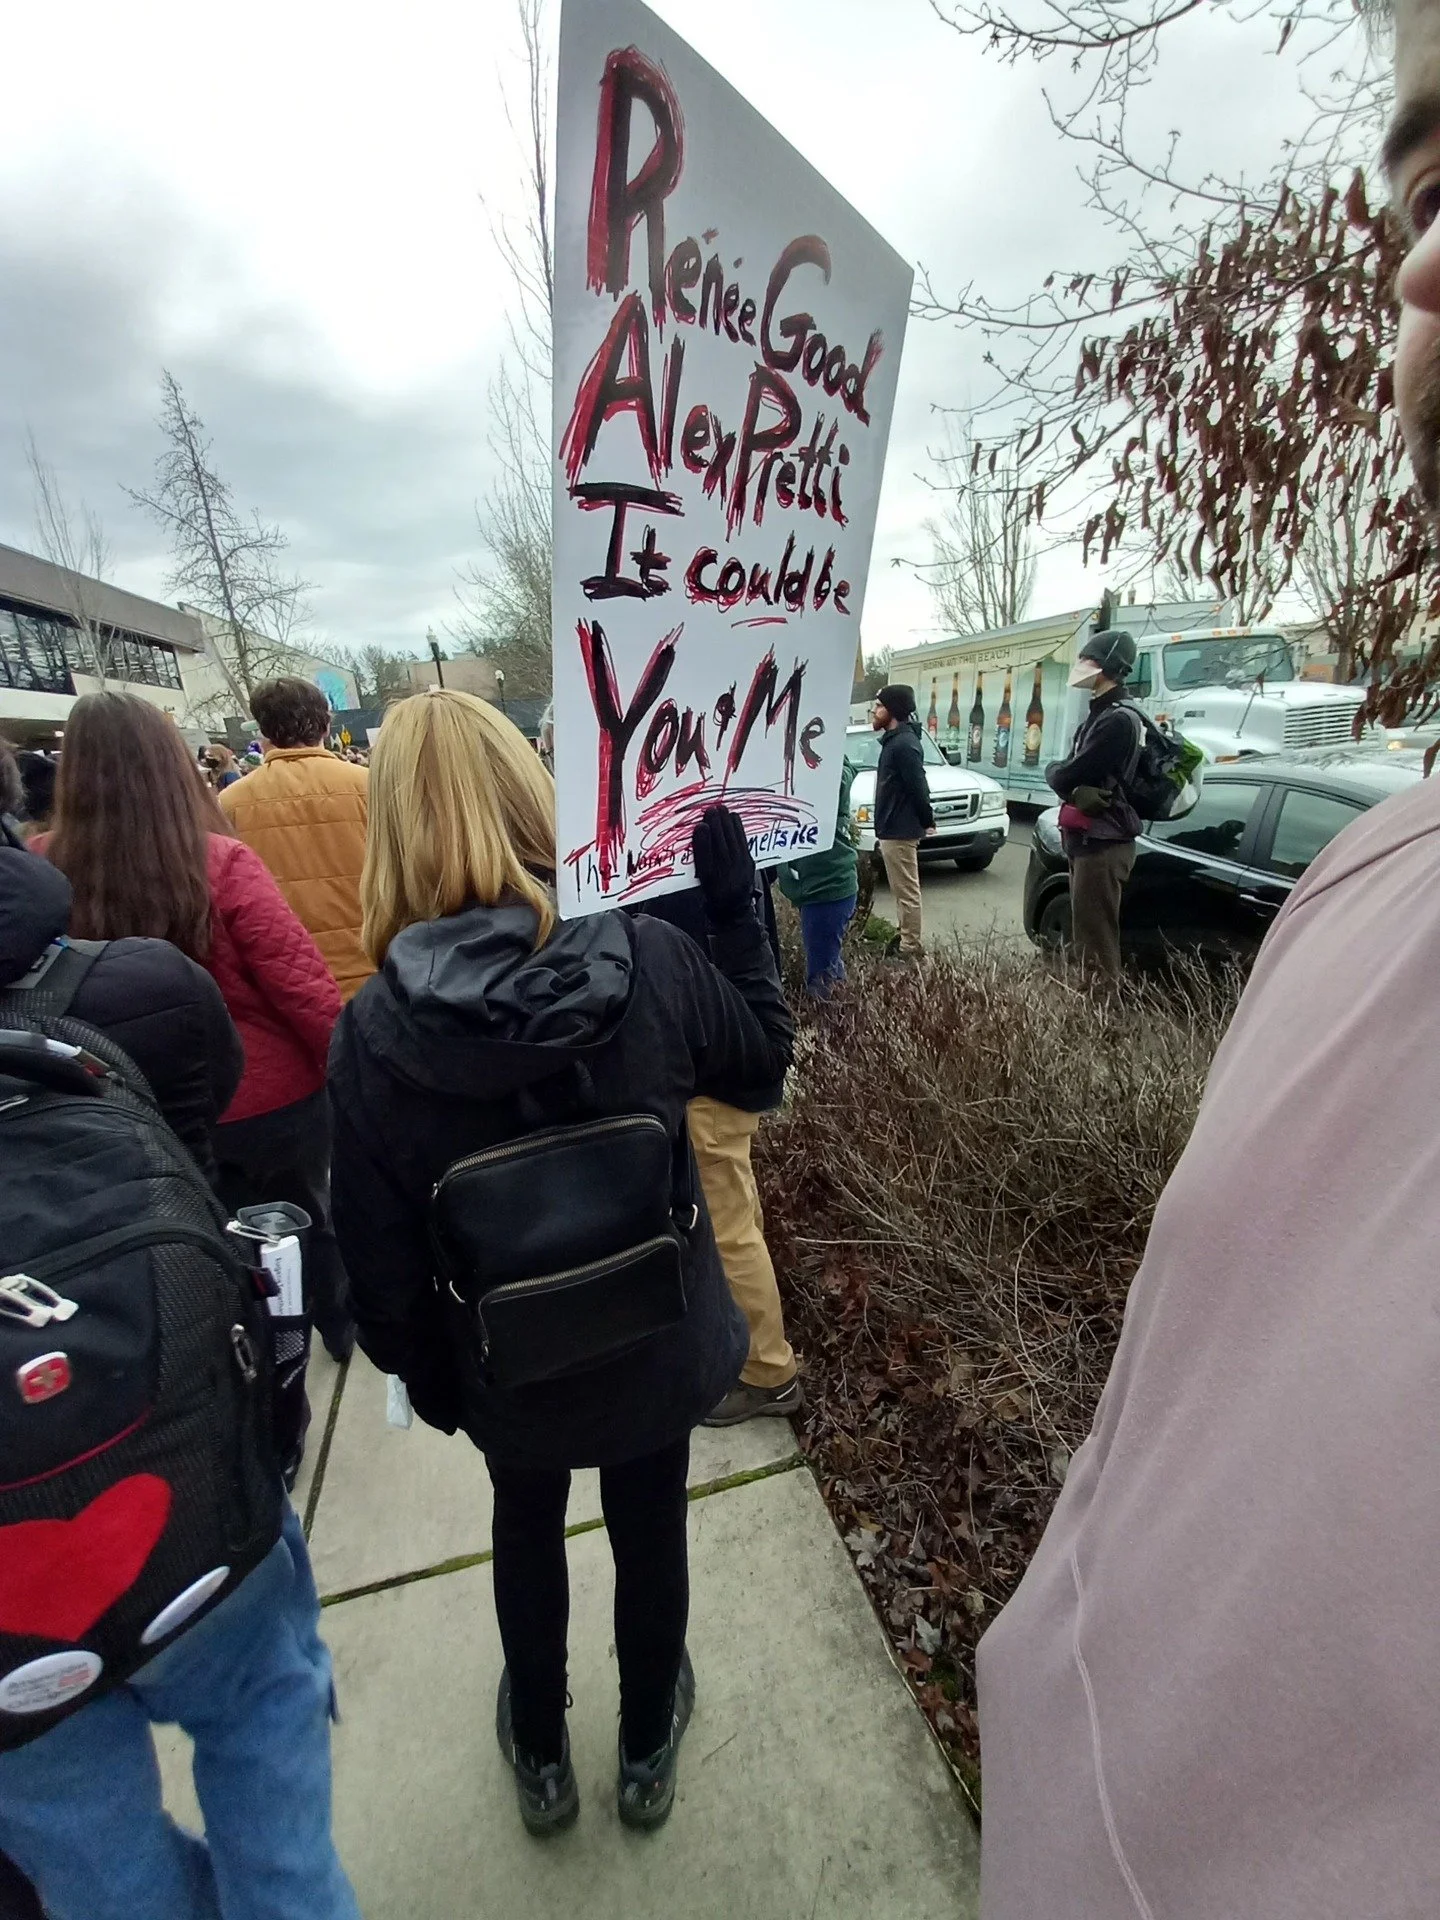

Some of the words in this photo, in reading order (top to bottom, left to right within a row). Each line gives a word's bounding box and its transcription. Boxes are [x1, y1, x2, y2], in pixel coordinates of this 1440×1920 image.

[760, 234, 885, 428] Good
[558, 289, 736, 510] Alex
[726, 361, 850, 543] Pretti
[567, 481, 685, 602] It
[684, 530, 813, 618] could
[812, 543, 852, 615] be
[977, 648, 1011, 663] BEACH
[575, 617, 711, 880] You
[724, 643, 826, 797] Me
[789, 821, 819, 850] ice
